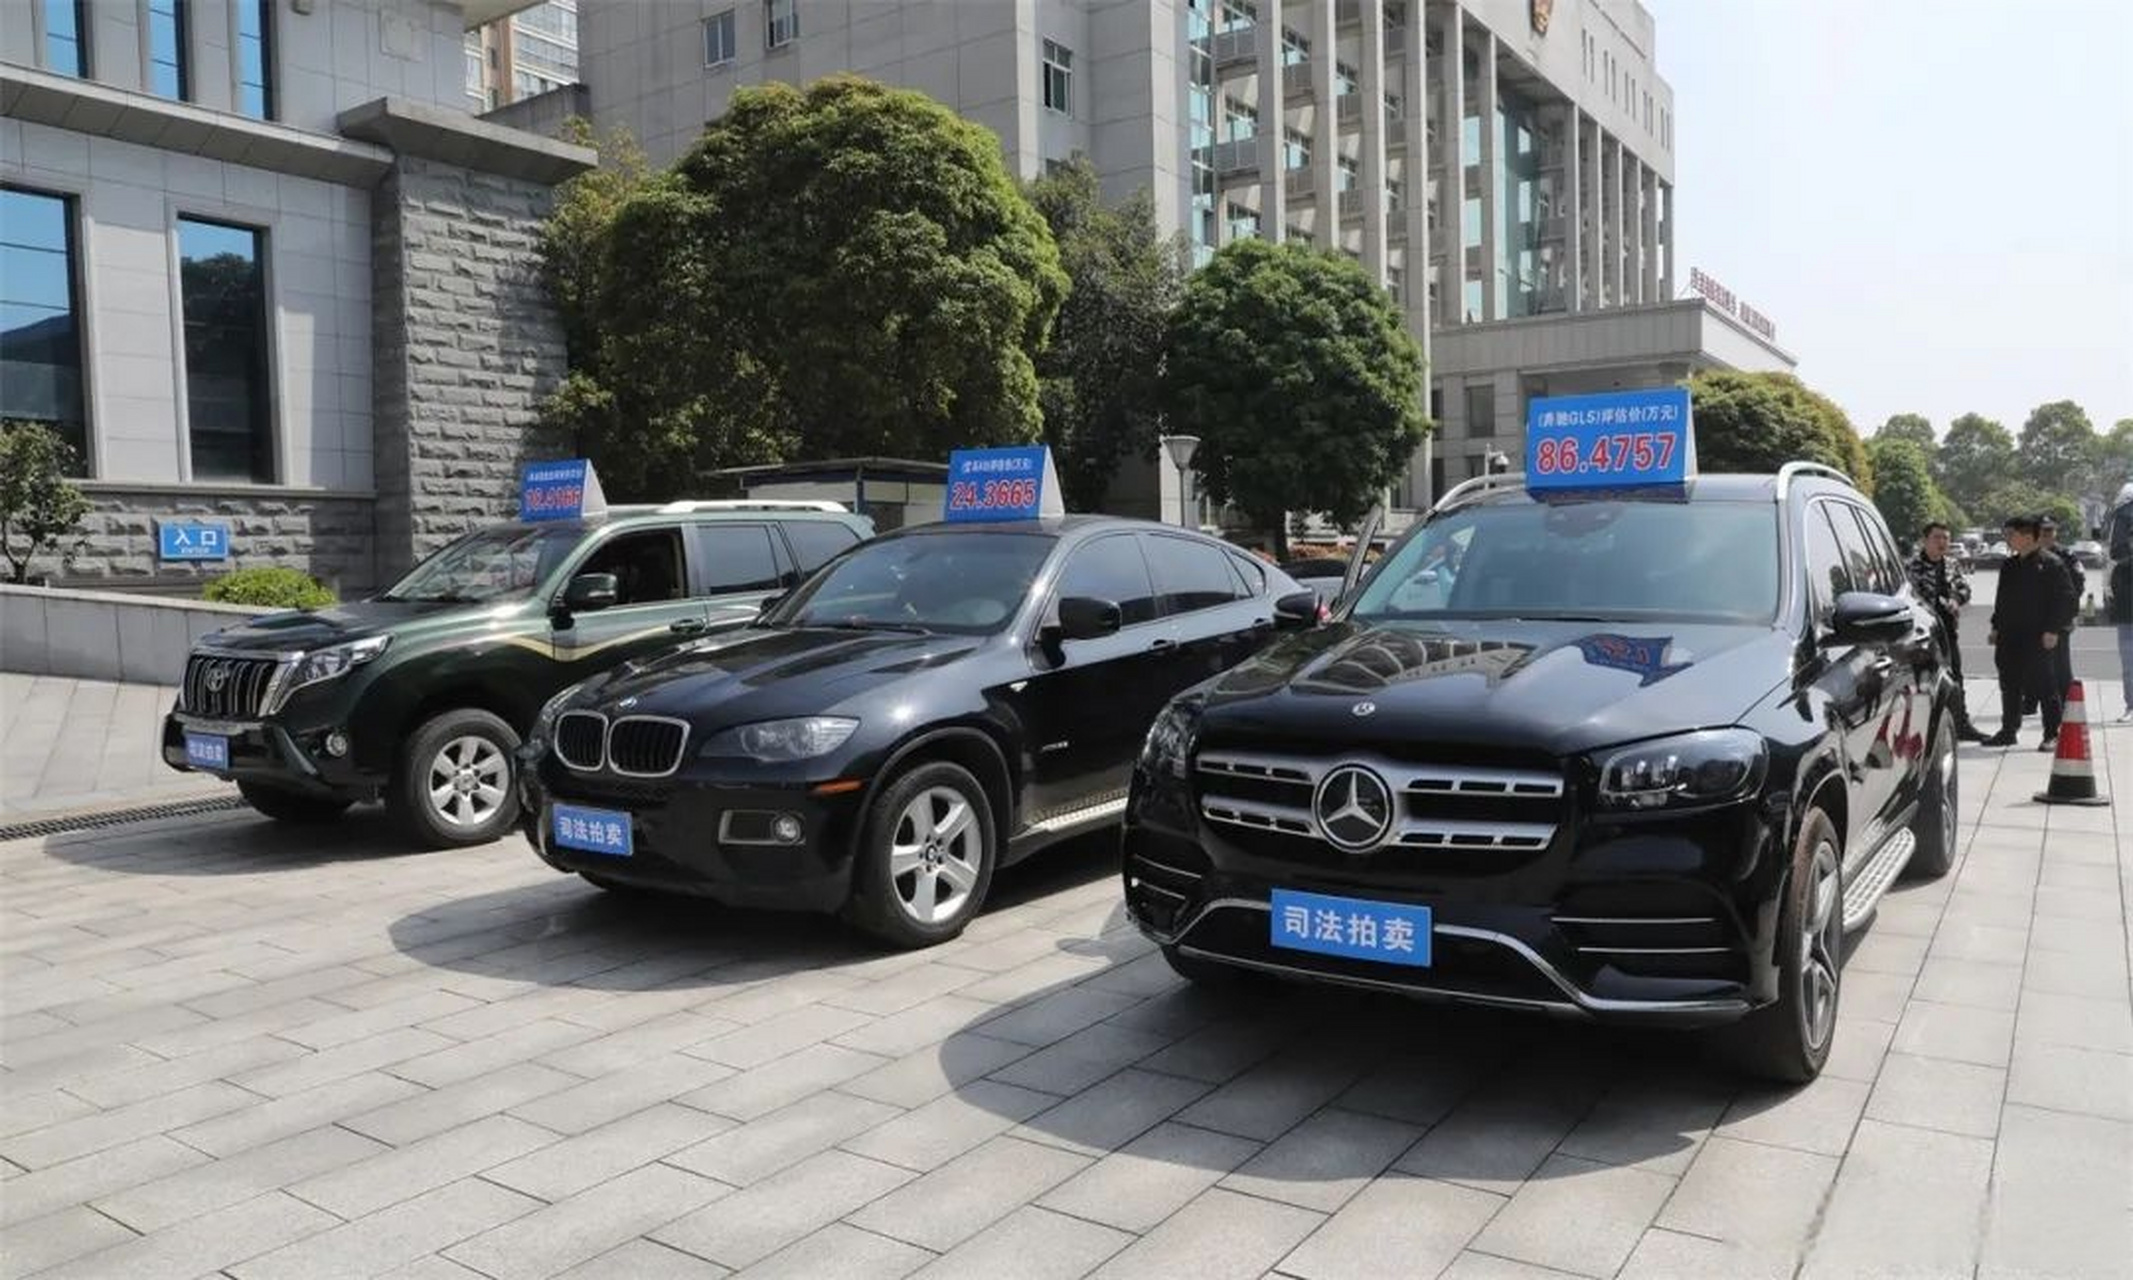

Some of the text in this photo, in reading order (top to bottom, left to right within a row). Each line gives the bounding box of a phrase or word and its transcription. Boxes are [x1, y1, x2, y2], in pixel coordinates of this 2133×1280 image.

[1536, 432, 1676, 475] 86.4757
[950, 478, 1037, 511] 24.3665
[173, 528, 217, 546] 入口
[558, 816, 622, 846] 司法拍卖
[1283, 905, 1416, 953] 司法拍卖
